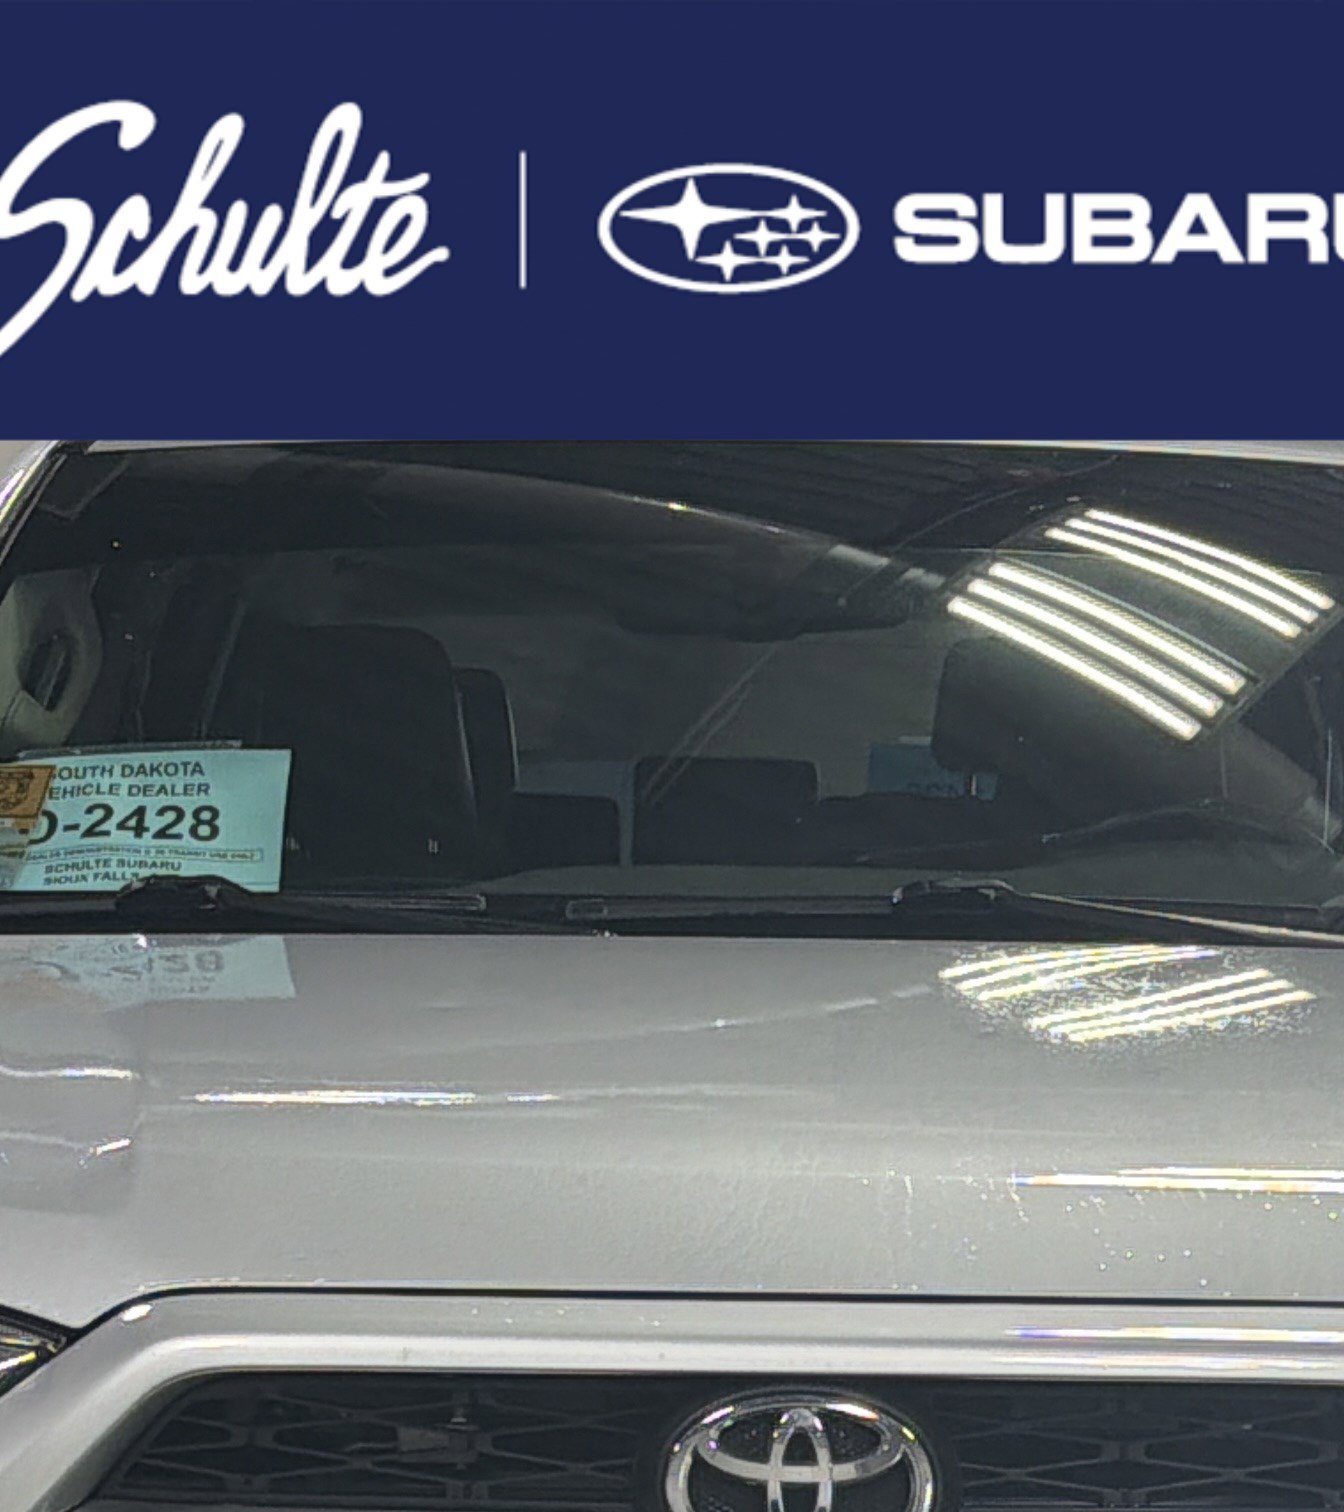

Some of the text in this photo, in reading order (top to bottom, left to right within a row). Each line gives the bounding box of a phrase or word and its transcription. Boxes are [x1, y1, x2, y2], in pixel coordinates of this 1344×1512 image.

[120, 761, 205, 778] DAKOTA
[48, 782, 211, 800] EHICLE DEALER
[45, 858, 182, 874] SCHULTE SUBARU
[44, 874, 88, 886] SIOUX
